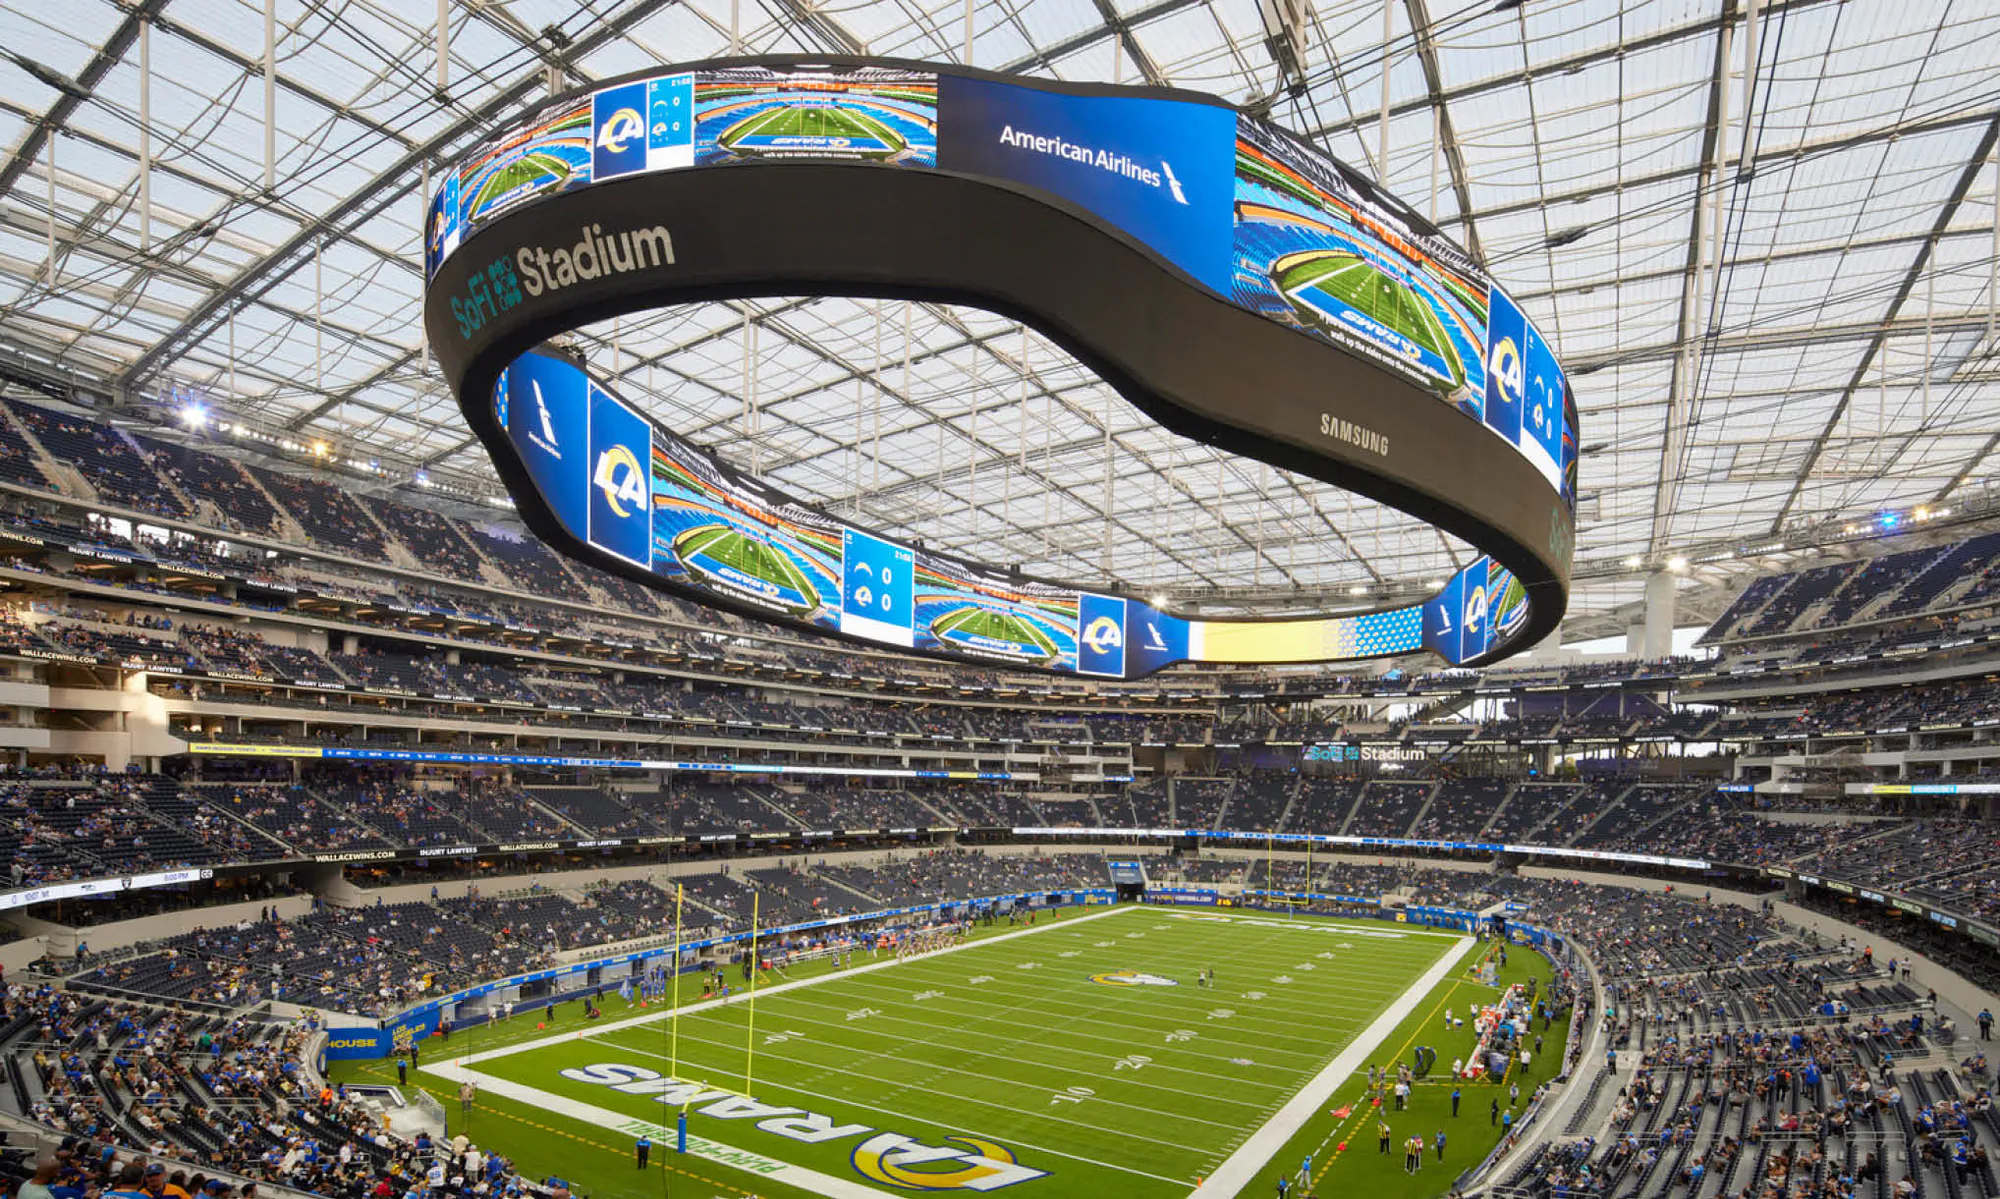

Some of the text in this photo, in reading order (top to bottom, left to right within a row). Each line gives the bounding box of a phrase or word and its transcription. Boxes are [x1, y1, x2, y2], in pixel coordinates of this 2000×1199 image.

[1000, 125, 1160, 187] American Airlines
[450, 222, 676, 340] SoFi Stadium
[1320, 413, 1389, 457] SAMSUNG
[881, 567, 892, 585] 0
[881, 593, 892, 612] 0
[1361, 746, 1425, 761] Stadium
[315, 851, 396, 863] WALLACEWINS.COM
[559, 1062, 877, 1144] RAMS
